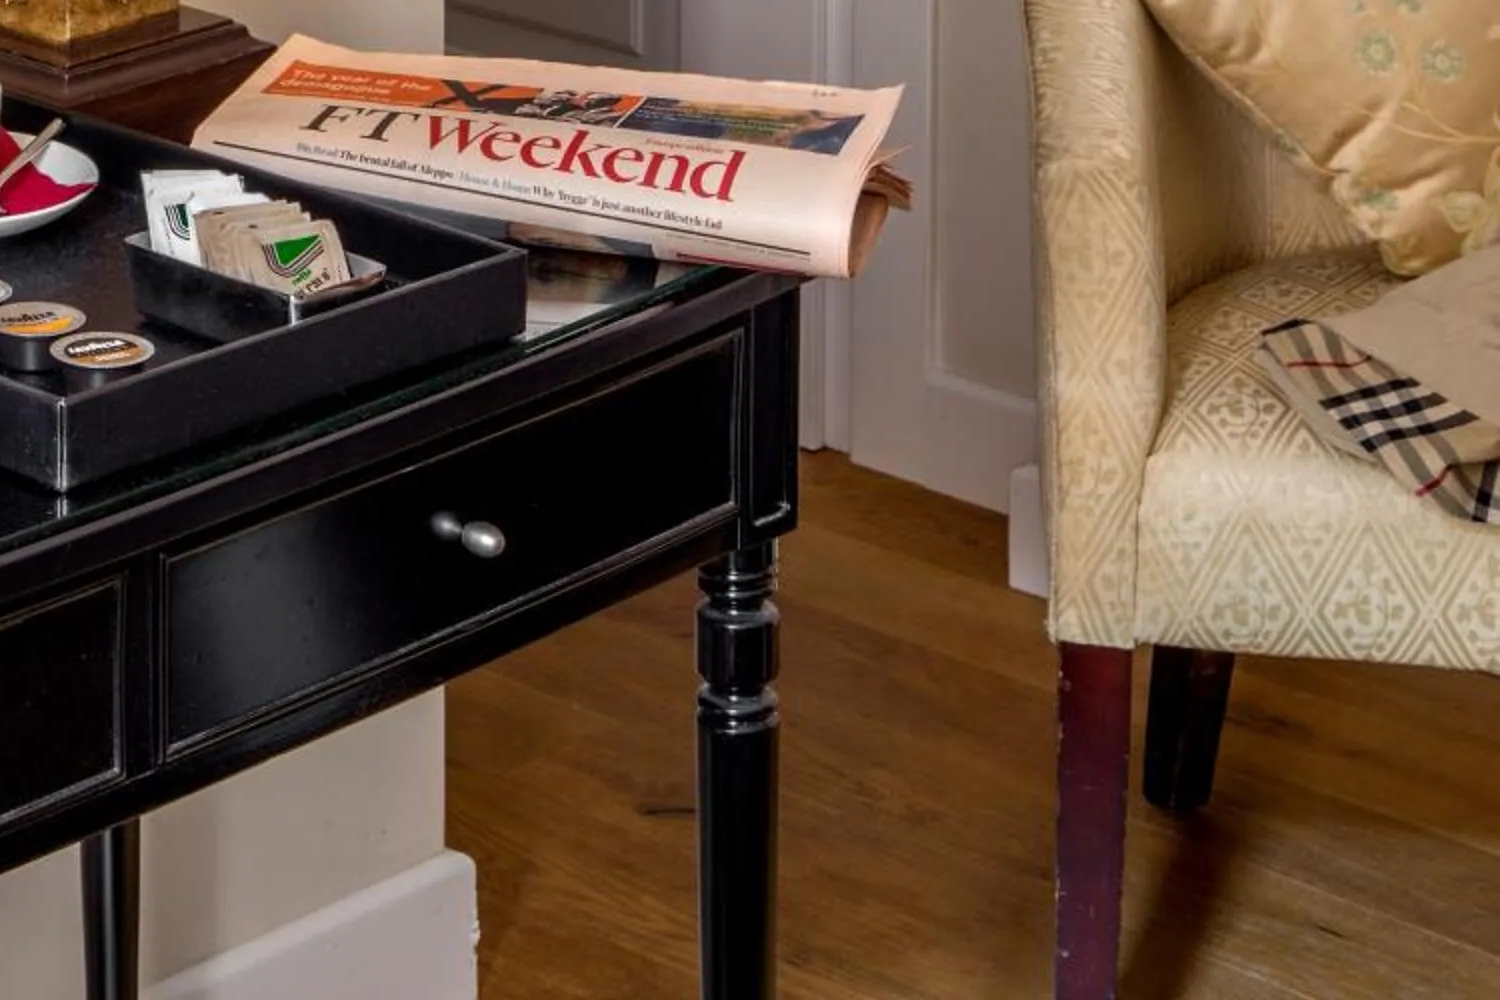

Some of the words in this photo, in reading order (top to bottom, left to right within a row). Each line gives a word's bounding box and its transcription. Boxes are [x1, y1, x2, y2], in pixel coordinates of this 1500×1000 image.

[298, 103, 421, 142] FT
[427, 115, 747, 203] Weekend
[339, 150, 358, 163] The
[358, 153, 391, 168] brutal
[420, 164, 454, 180] Aleppo
[533, 185, 554, 200] Why
[601, 198, 621, 213] just
[622, 203, 662, 220] another
